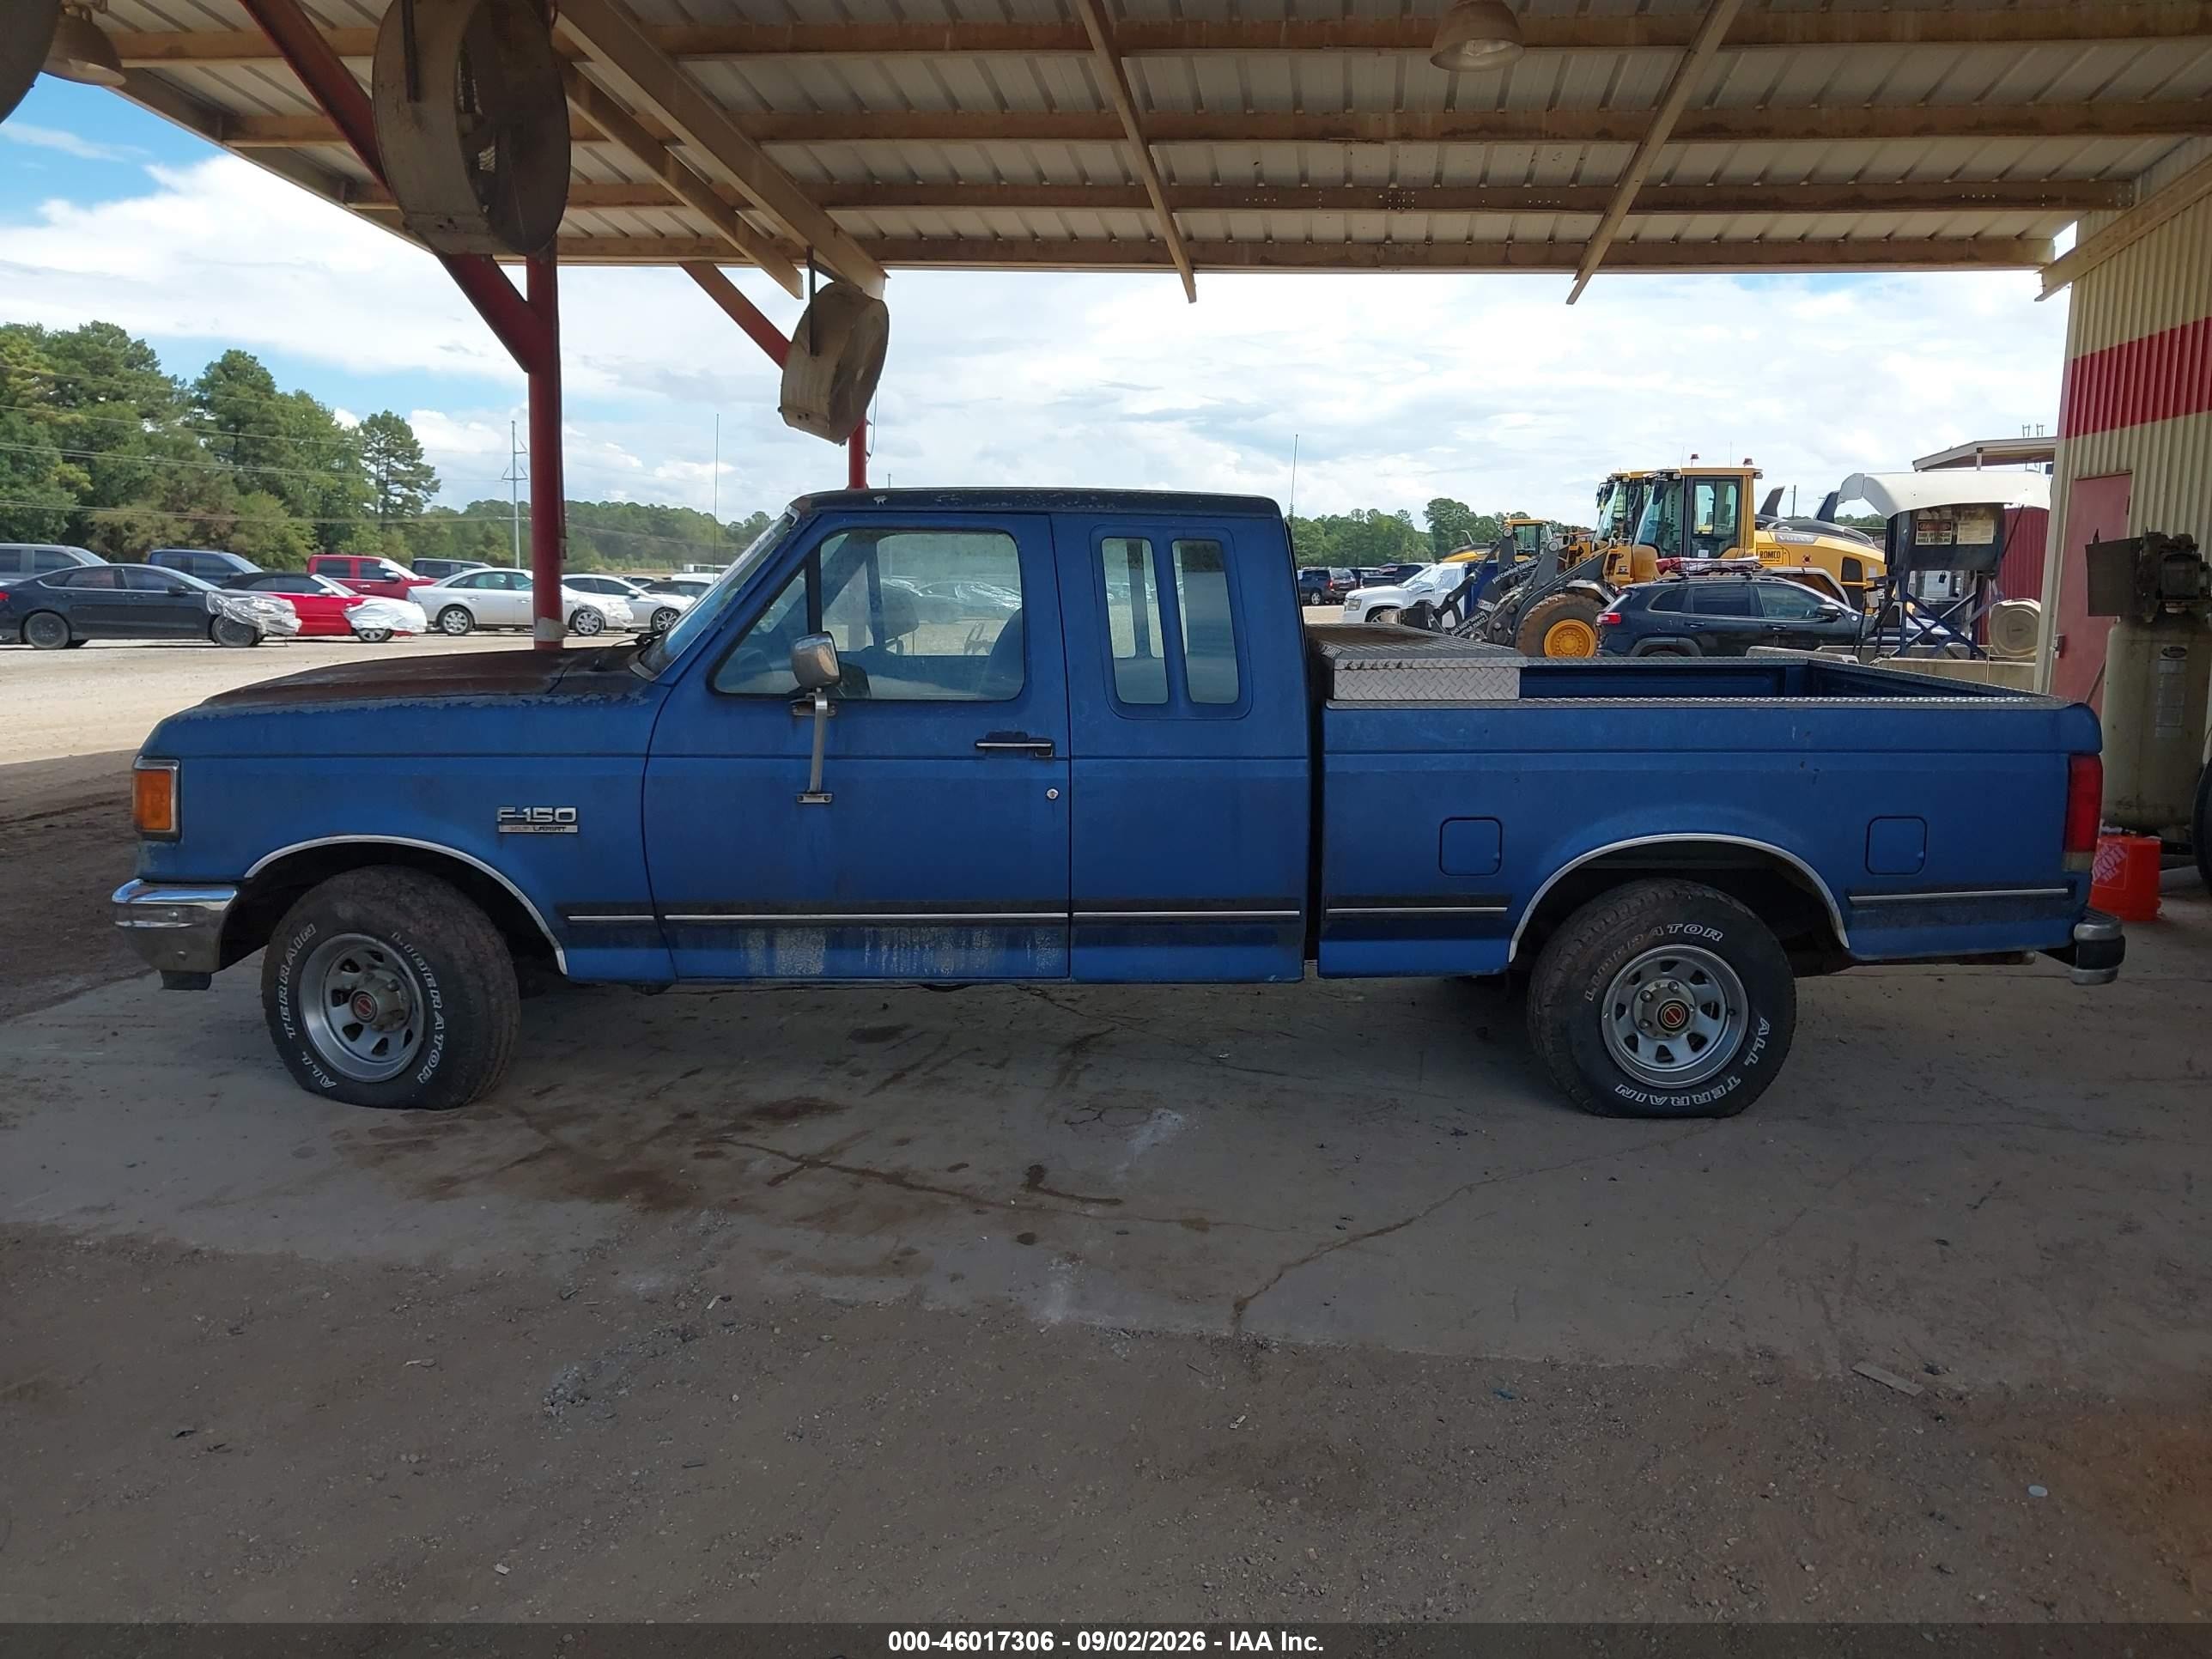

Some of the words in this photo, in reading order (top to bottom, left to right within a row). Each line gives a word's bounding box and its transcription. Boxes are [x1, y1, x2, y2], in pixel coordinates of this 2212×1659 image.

[1759, 550, 1781, 559] ROMCO
[497, 806, 576, 823] F-150
[277, 922, 317, 1040] TERRAIN
[391, 931, 445, 1084] LIBERATOR
[1743, 1016, 1771, 1066] ALL
[301, 1051, 337, 1088] ALL
[1614, 1075, 1741, 1107] TERRAIN
